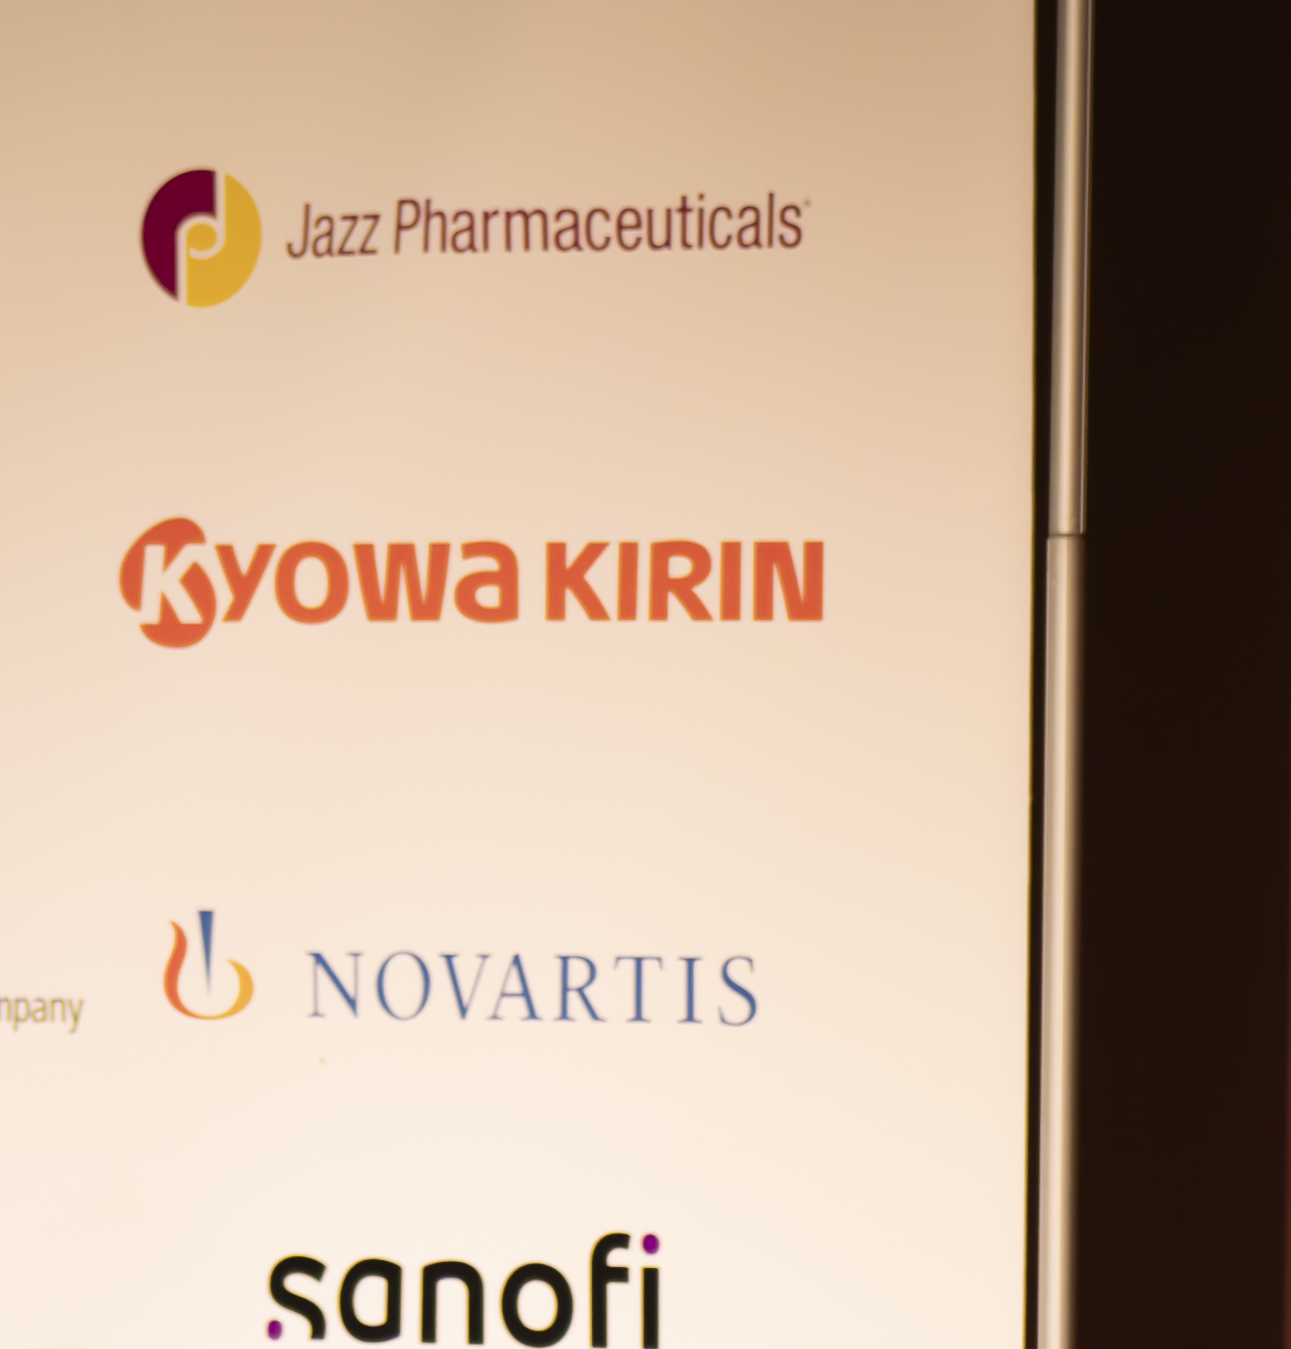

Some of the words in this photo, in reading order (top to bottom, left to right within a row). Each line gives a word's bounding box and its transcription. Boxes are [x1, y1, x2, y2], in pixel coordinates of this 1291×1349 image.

[286, 201, 380, 260] Jazz
[394, 192, 804, 254] Pharmaceuticals
[545, 540, 824, 622] KIRIN
[306, 950, 760, 1027] NOVARTIS
